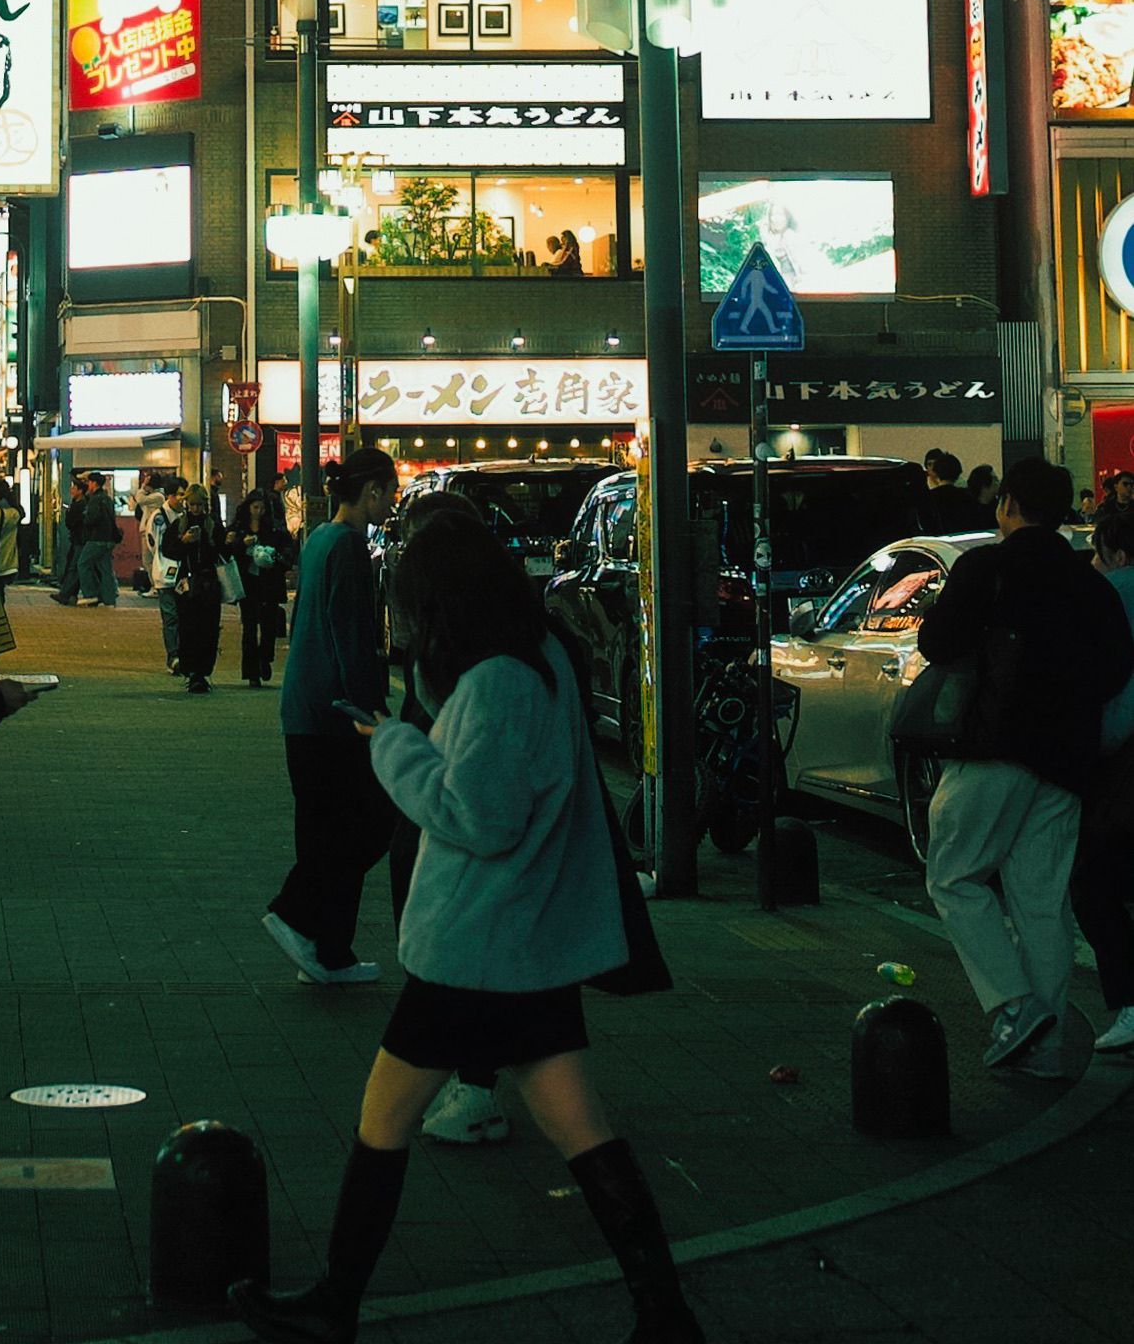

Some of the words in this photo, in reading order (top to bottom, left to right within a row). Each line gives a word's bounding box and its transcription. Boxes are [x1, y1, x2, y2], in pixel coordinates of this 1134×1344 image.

[83, 34, 197, 95] プレゼント中
[367, 105, 621, 127] 山下本気うどん
[279, 442, 342, 458] RAEN
